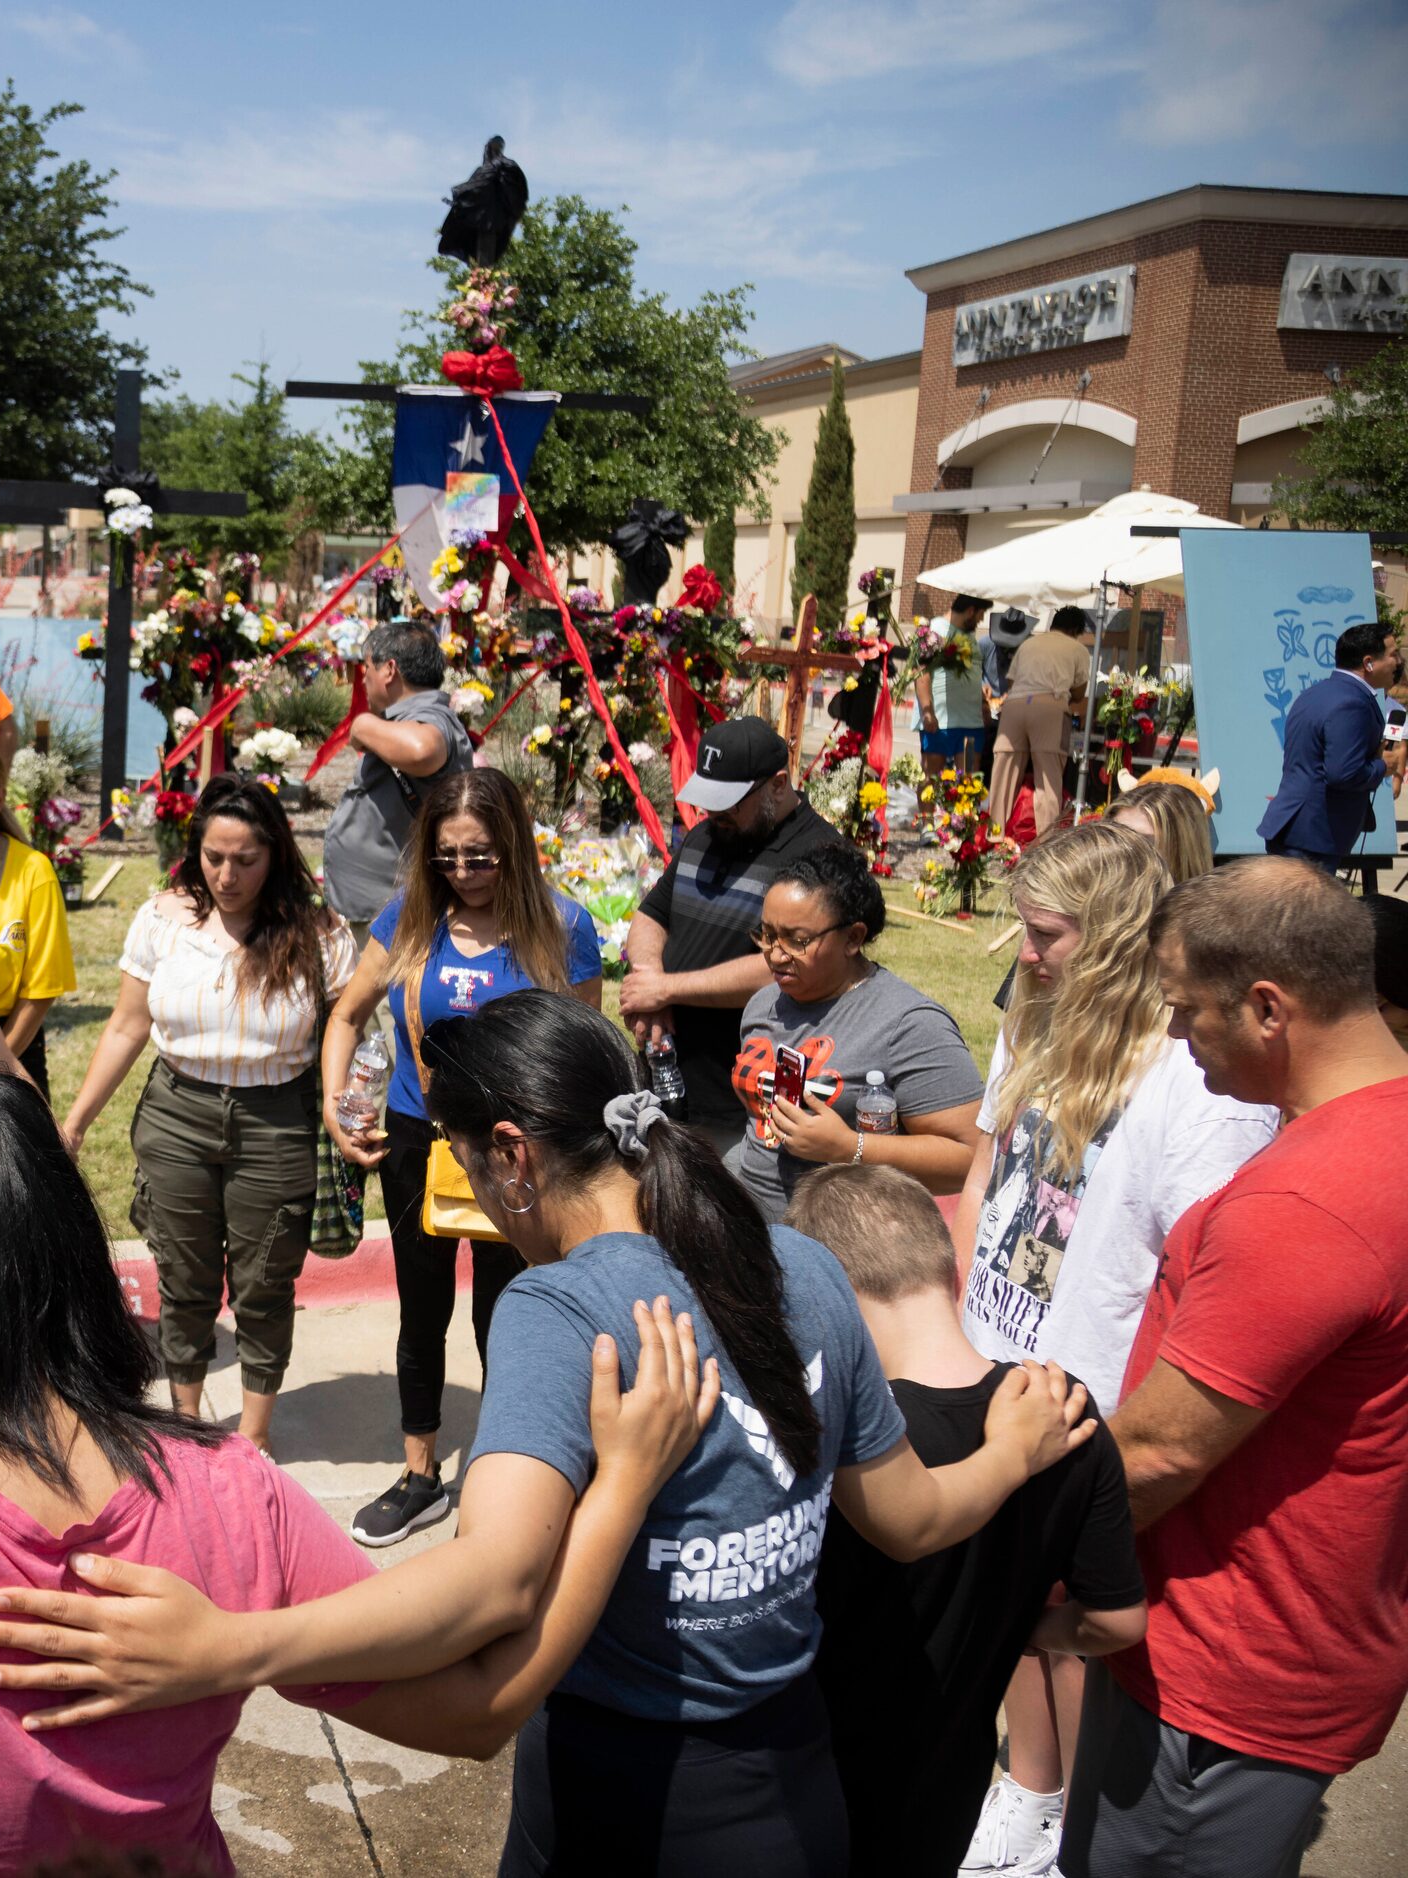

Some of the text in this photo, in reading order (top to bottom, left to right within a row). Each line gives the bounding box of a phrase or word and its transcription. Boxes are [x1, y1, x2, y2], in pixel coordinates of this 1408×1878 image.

[1297, 264, 1402, 296] ANN
[957, 279, 1119, 335] ANN TAYLOR
[703, 744, 721, 771] T
[439, 966, 494, 1012] T
[989, 1276, 1051, 1335] SWIFT
[996, 1314, 1037, 1353] TOUR
[665, 1617, 728, 1631] WHERE
[730, 1606, 764, 1628] BOYS
